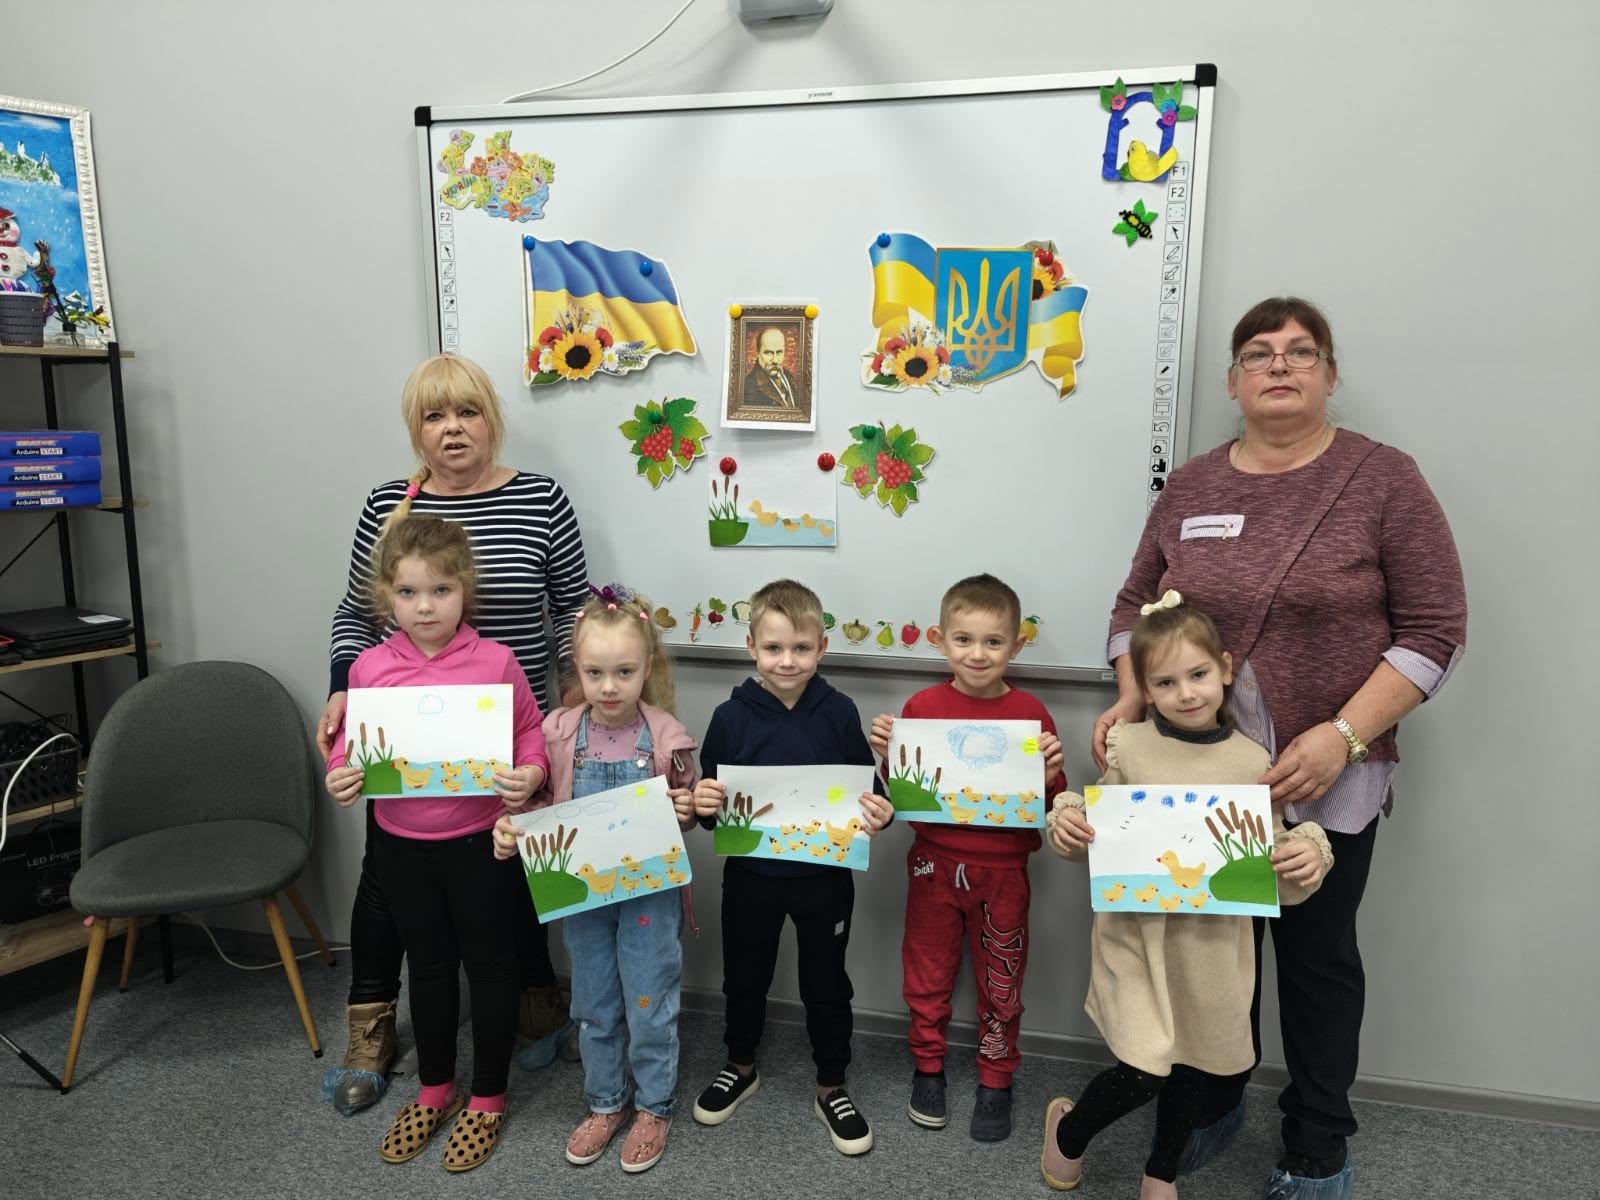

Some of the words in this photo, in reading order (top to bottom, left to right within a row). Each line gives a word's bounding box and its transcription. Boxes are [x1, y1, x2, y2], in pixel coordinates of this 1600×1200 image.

[1172, 166, 1186, 177] F1
[1171, 187, 1185, 198] F2
[440, 212, 451, 221] F2
[28, 856, 48, 868] LED
[50, 848, 81, 861] Projec
